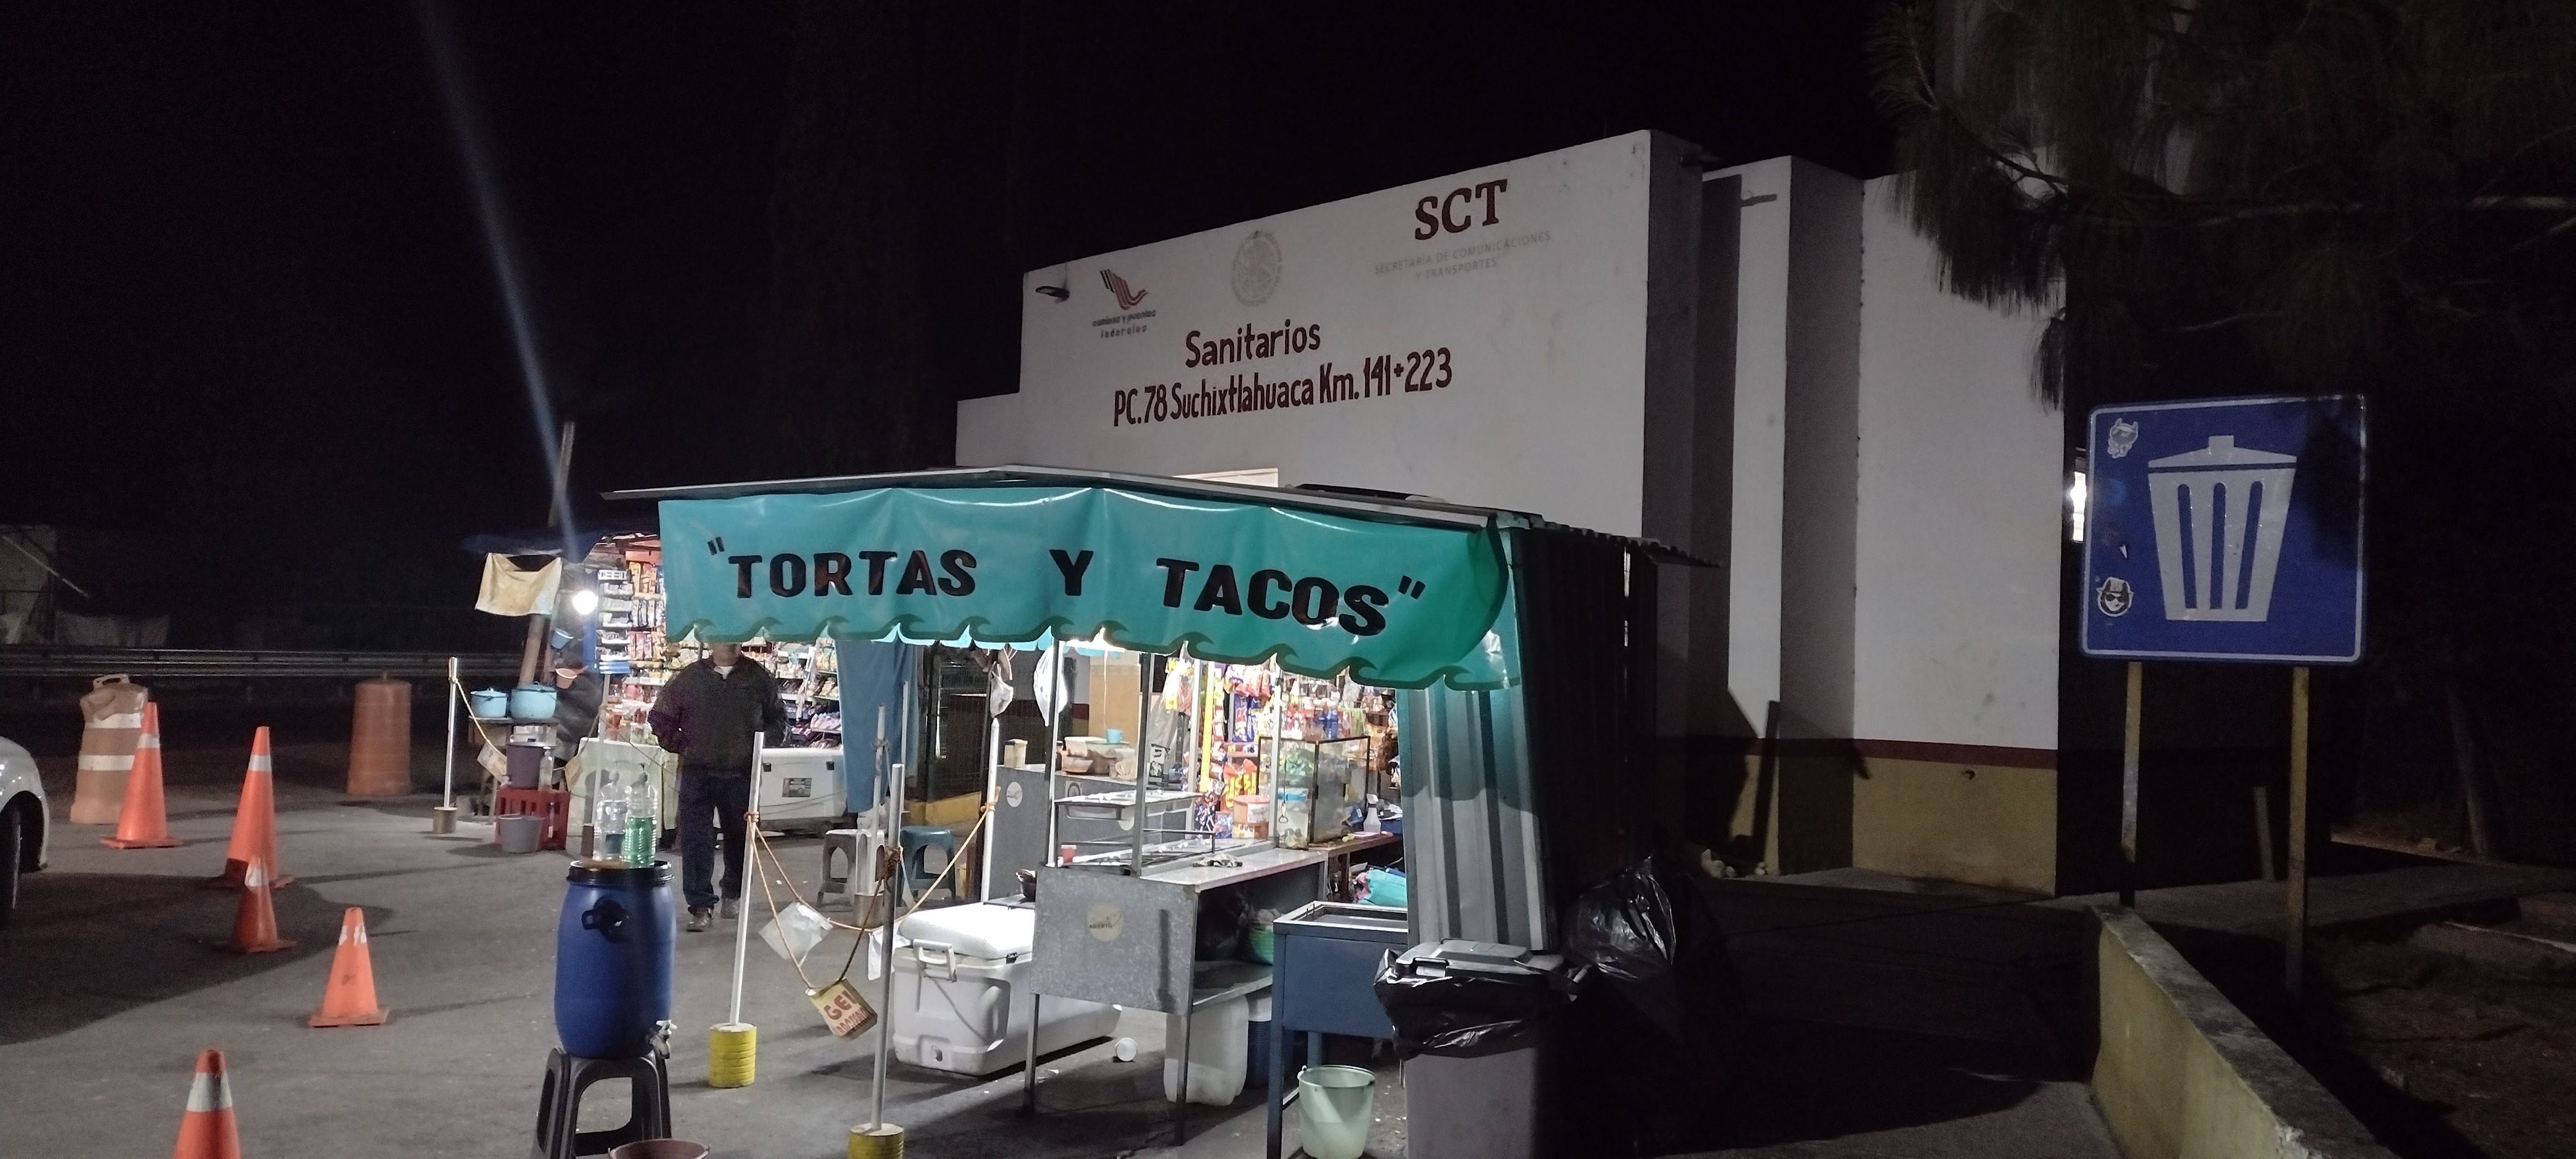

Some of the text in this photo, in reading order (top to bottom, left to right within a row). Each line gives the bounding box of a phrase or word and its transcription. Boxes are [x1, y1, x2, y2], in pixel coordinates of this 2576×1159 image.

[1415, 178, 1507, 240] SCT
[1425, 257, 1497, 280] TRANSPORTES
[1436, 251, 1450, 263] DE
[1453, 230, 1552, 260] COMUNICACIONES
[1101, 324, 1147, 339] federales
[1185, 319, 1321, 368] Sanitarios
[1170, 372, 1314, 420] Suchixtlahuaca
[1319, 362, 1359, 404] Km.
[1363, 347, 1452, 398] 141+223
[1049, 549, 1094, 597] Y
